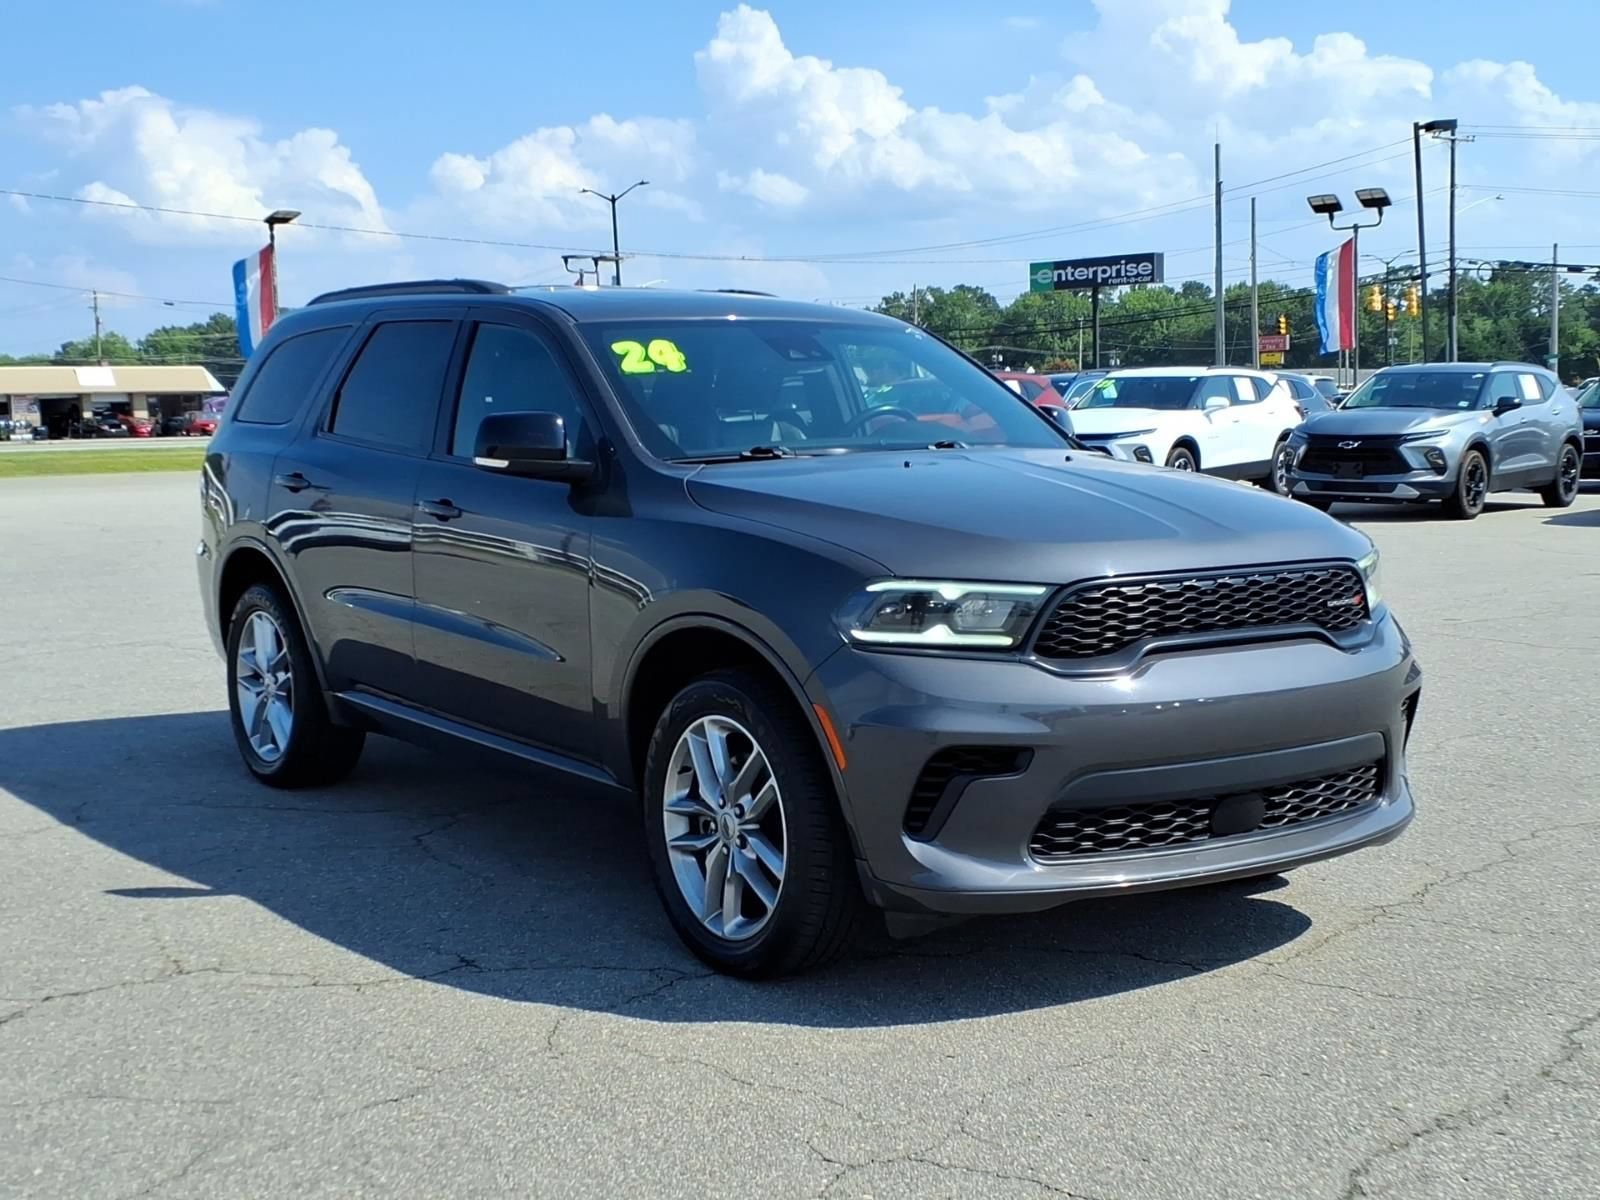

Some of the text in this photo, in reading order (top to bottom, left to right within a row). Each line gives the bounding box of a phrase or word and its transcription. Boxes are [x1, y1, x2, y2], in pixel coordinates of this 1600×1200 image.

[1033, 260, 1153, 284] enterprise
[1108, 275, 1153, 285] rent-a-car
[610, 339, 687, 374] 24
